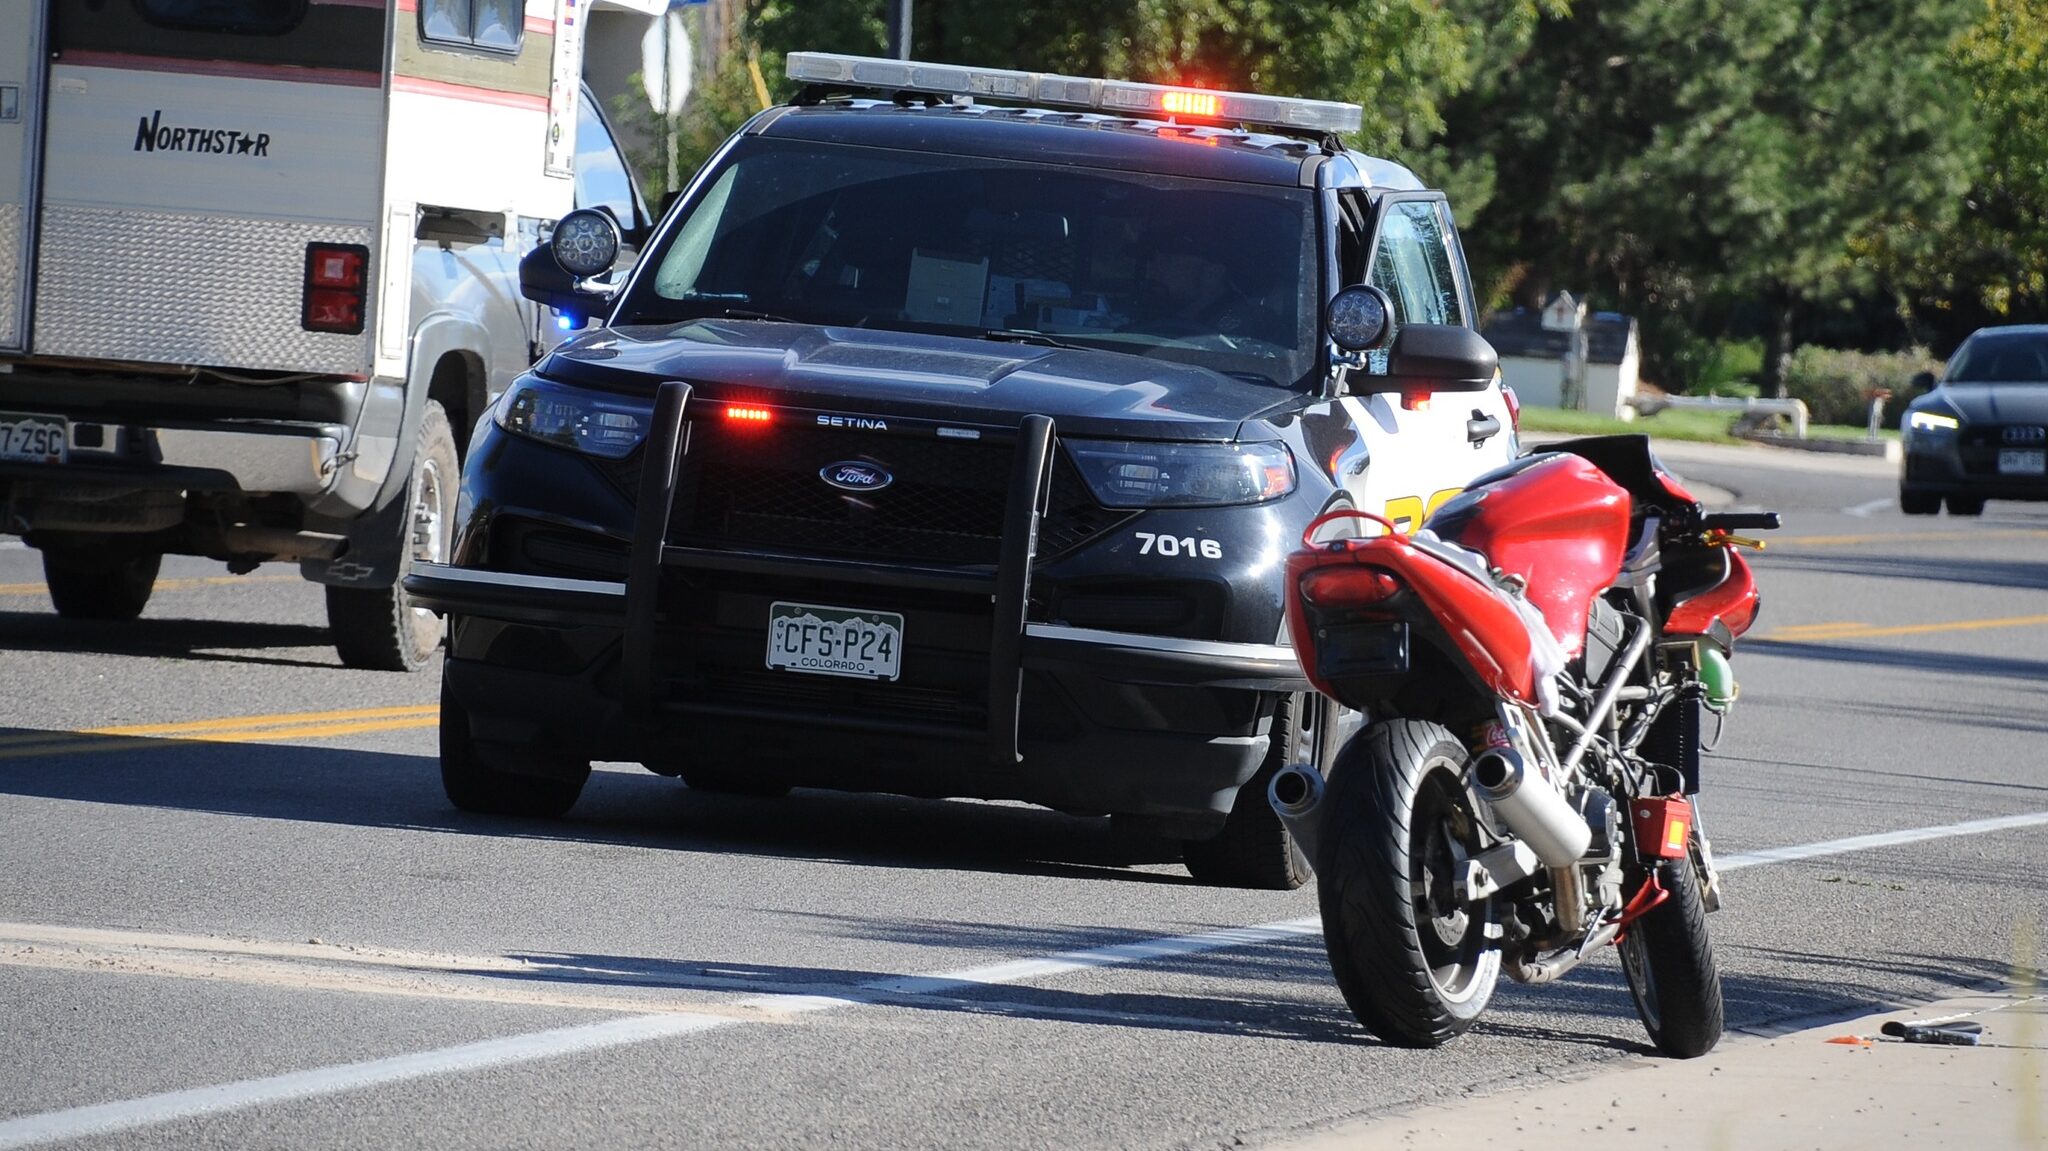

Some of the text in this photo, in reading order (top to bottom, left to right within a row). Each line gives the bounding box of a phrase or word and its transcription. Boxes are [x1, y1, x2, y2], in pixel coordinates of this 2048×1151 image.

[816, 415, 888, 430] SETINA
[836, 466, 876, 485] Ford
[1135, 532, 1222, 559] 7016
[801, 657, 866, 672] COLORADO
